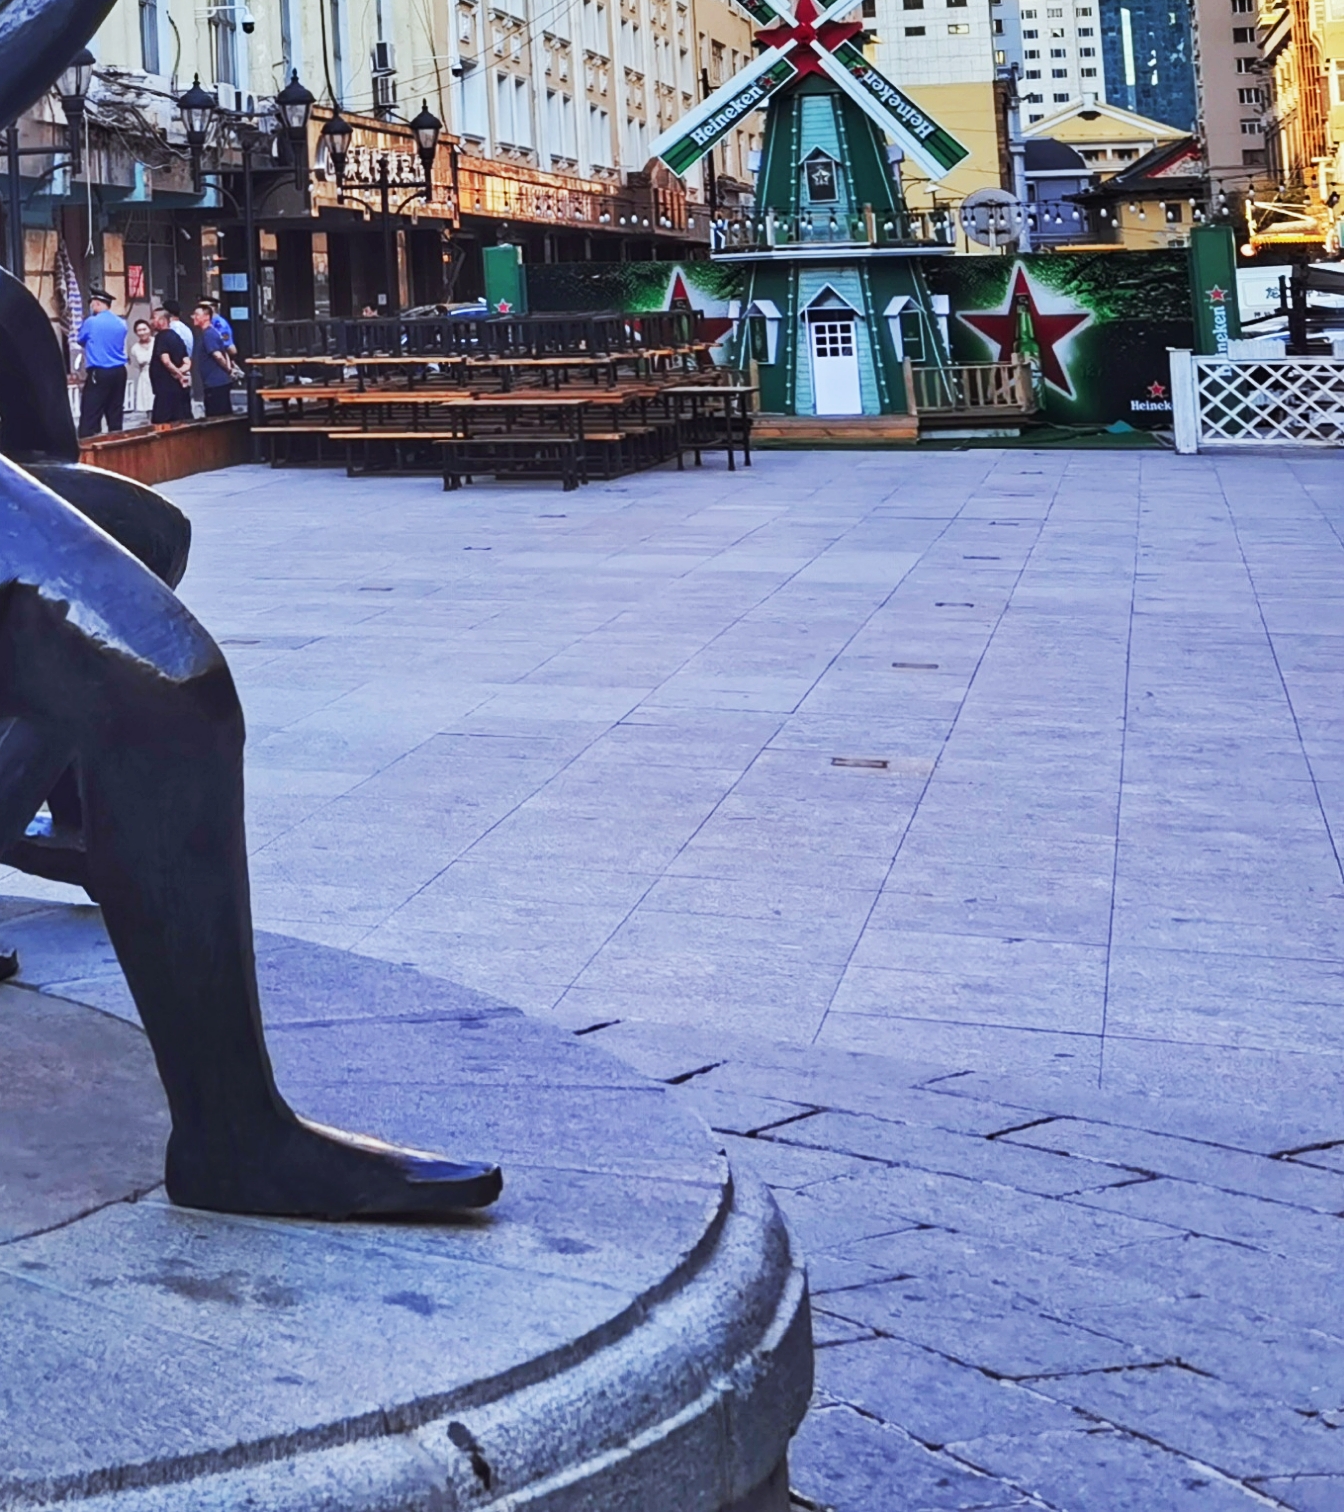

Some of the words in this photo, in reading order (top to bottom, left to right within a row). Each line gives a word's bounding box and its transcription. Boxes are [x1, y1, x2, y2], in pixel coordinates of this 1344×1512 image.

[689, 84, 764, 148] Heineken
[862, 71, 936, 139] Heineken
[1130, 400, 1172, 411] Heinek
